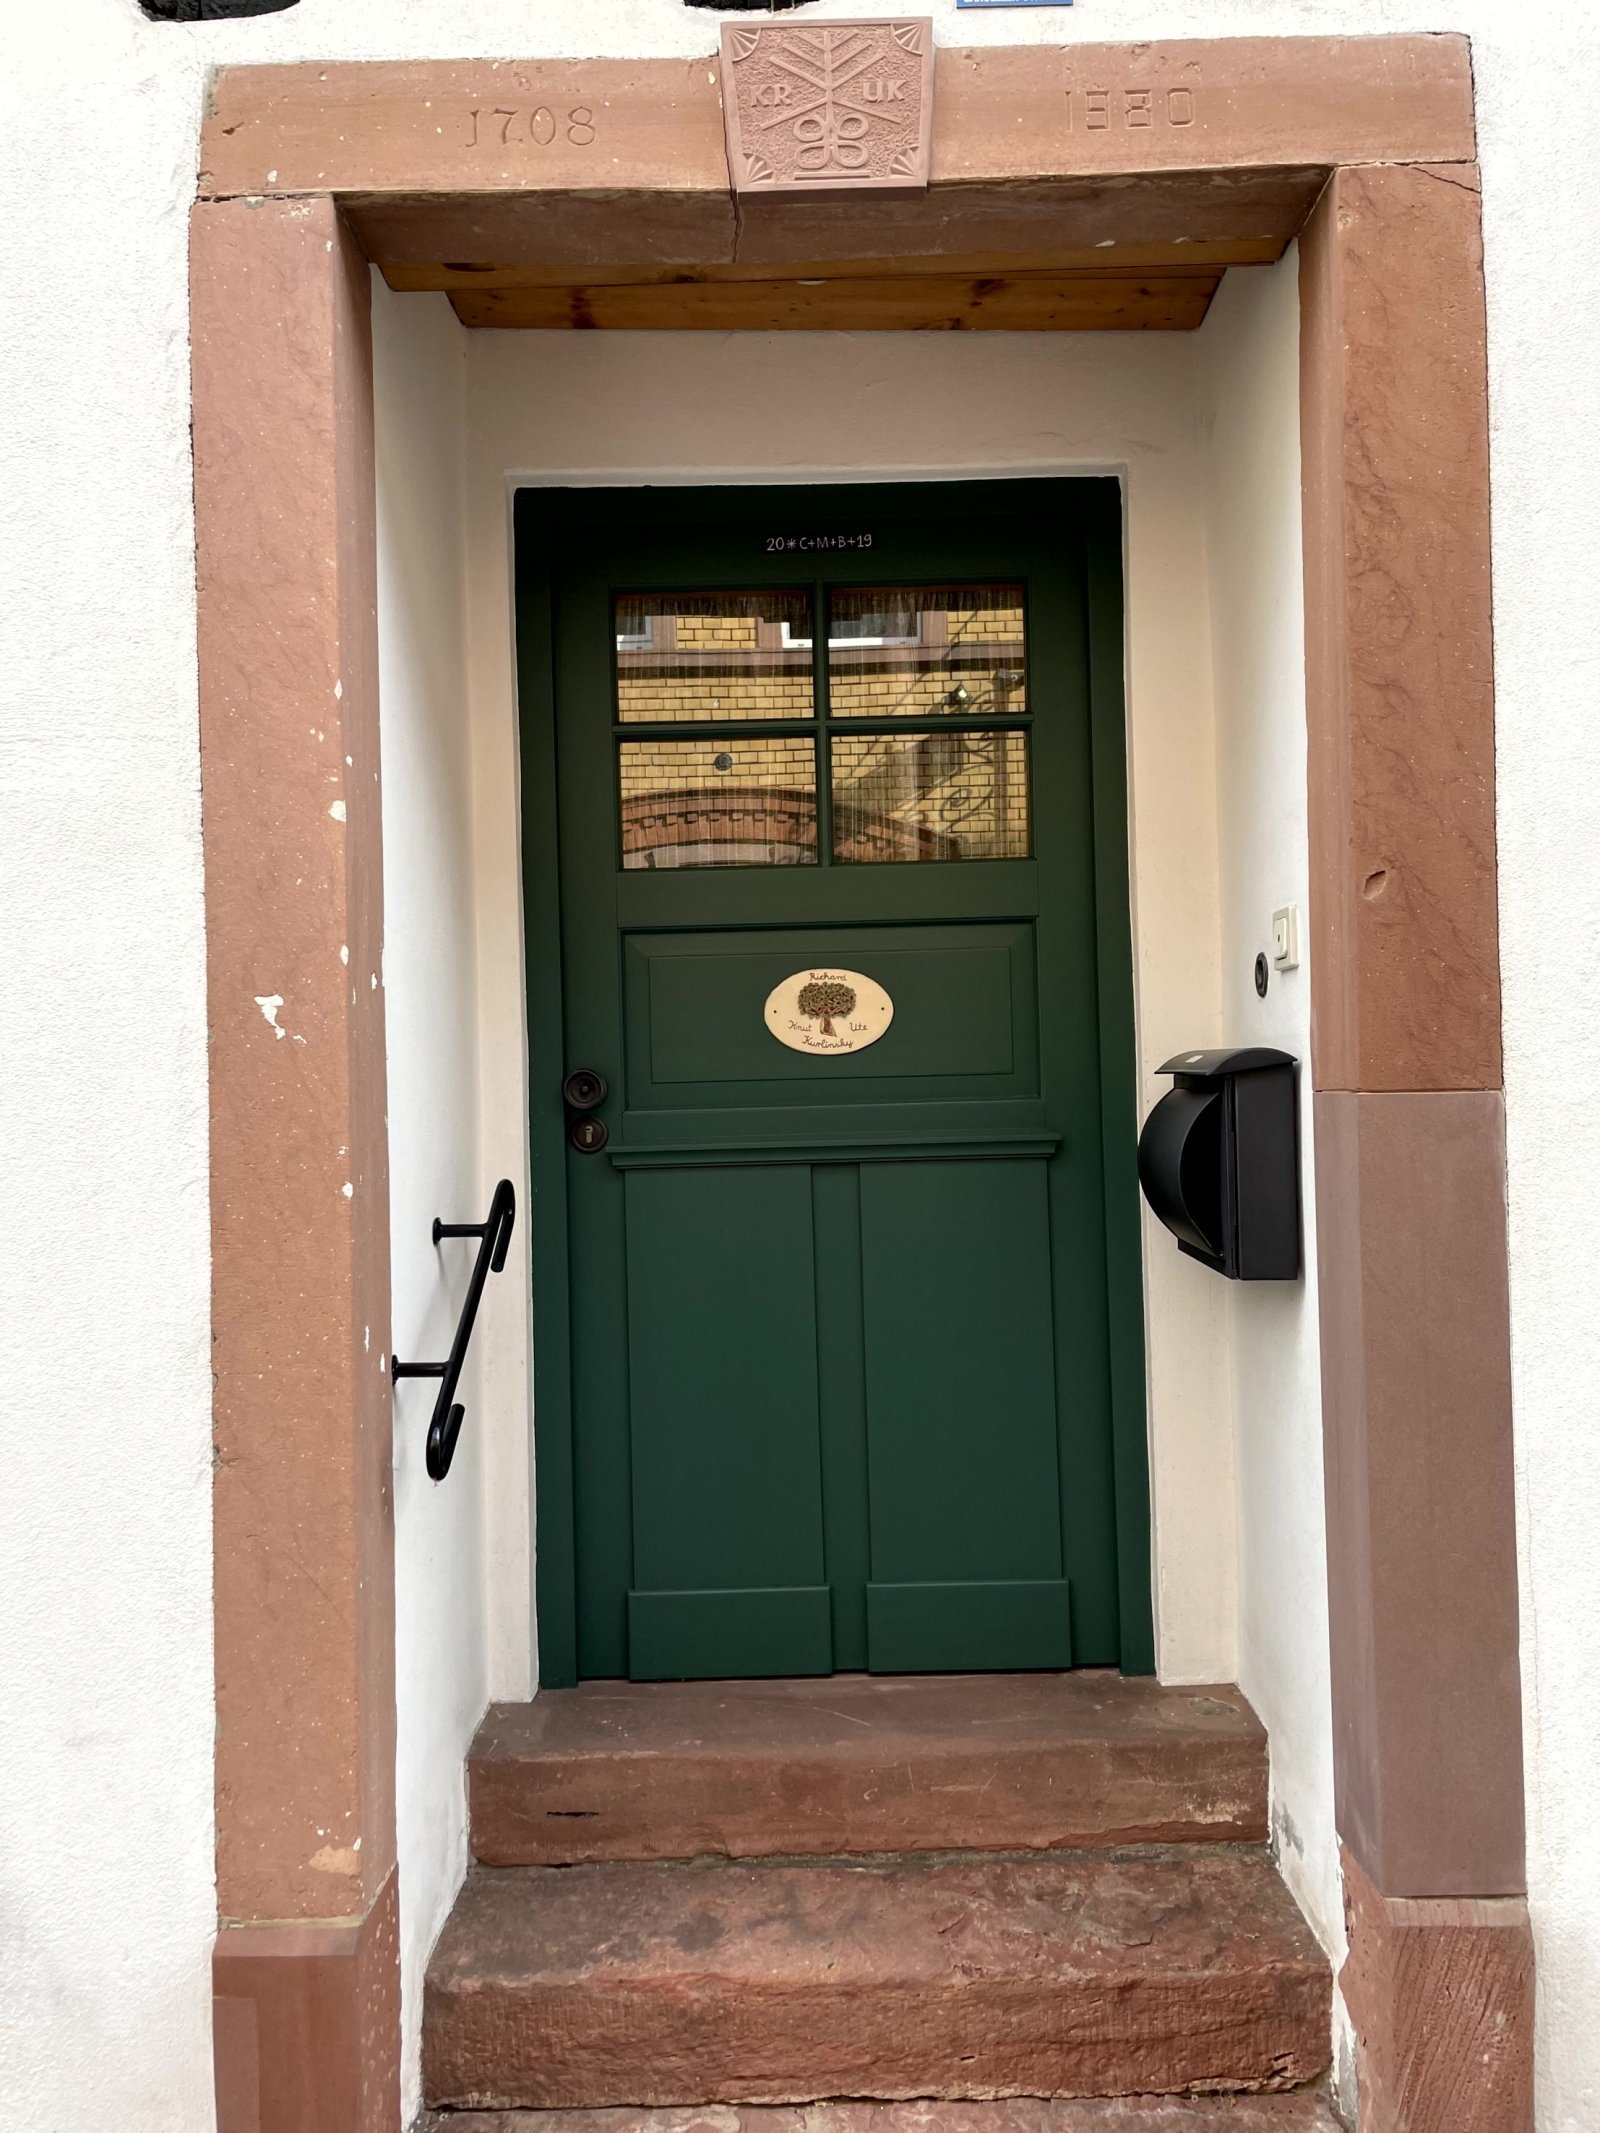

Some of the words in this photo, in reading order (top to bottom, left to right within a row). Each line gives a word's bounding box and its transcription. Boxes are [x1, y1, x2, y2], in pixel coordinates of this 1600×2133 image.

[750, 83, 793, 108] KR
[860, 79, 909, 104] UK
[465, 104, 596, 148] 1708
[809, 972, 847, 982] Richard
[788, 1020, 812, 1032] Knut
[850, 1022, 868, 1032] Ute
